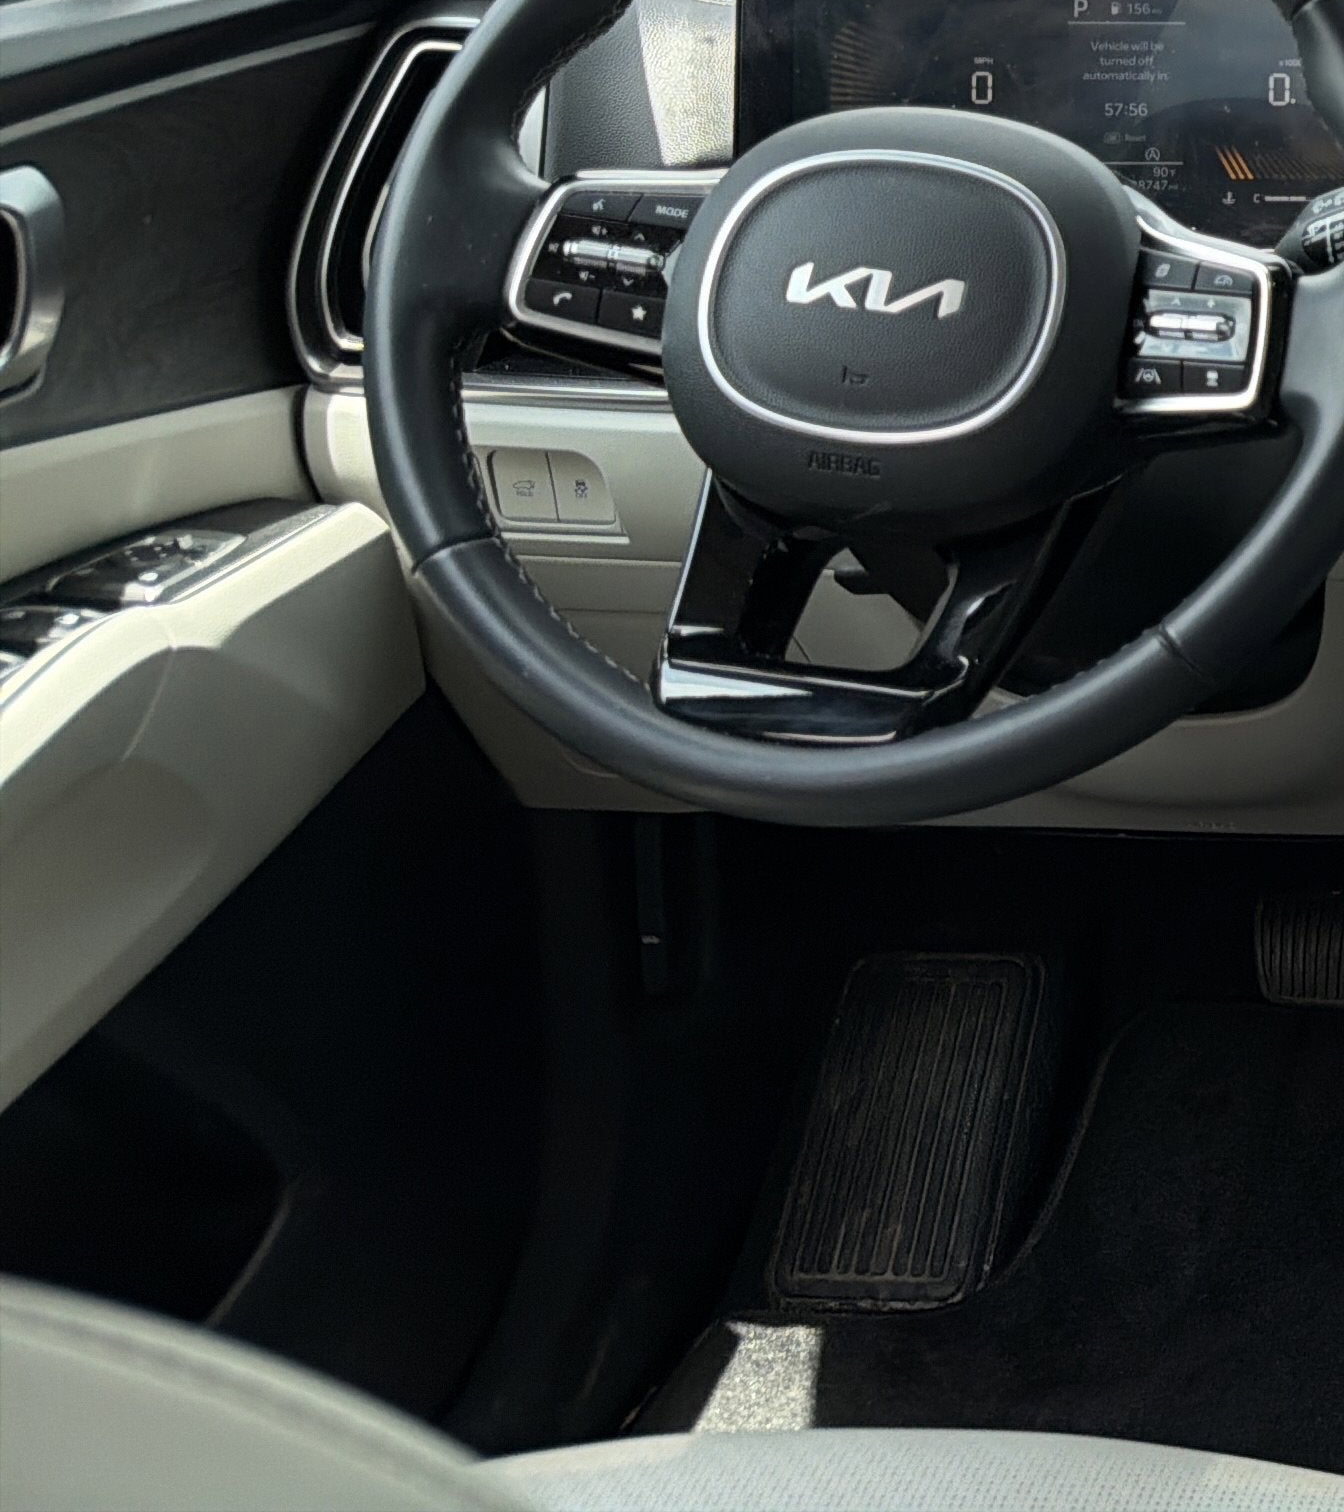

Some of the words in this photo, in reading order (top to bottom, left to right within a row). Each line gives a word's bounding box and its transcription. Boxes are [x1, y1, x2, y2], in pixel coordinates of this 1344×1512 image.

[1127, 3, 1151, 15] 156
[1090, 41, 1130, 52] Vehicle
[1130, 41, 1147, 52] will
[1148, 41, 1165, 52] be
[1100, 56, 1136, 67] turned
[1082, 70, 1156, 82] automatically
[971, 71, 994, 105] 0
[1104, 103, 1149, 117] 57:56
[655, 205, 690, 219] MODE
[785, 261, 966, 320] KIA
[806, 448, 882, 478] AIRBAG
